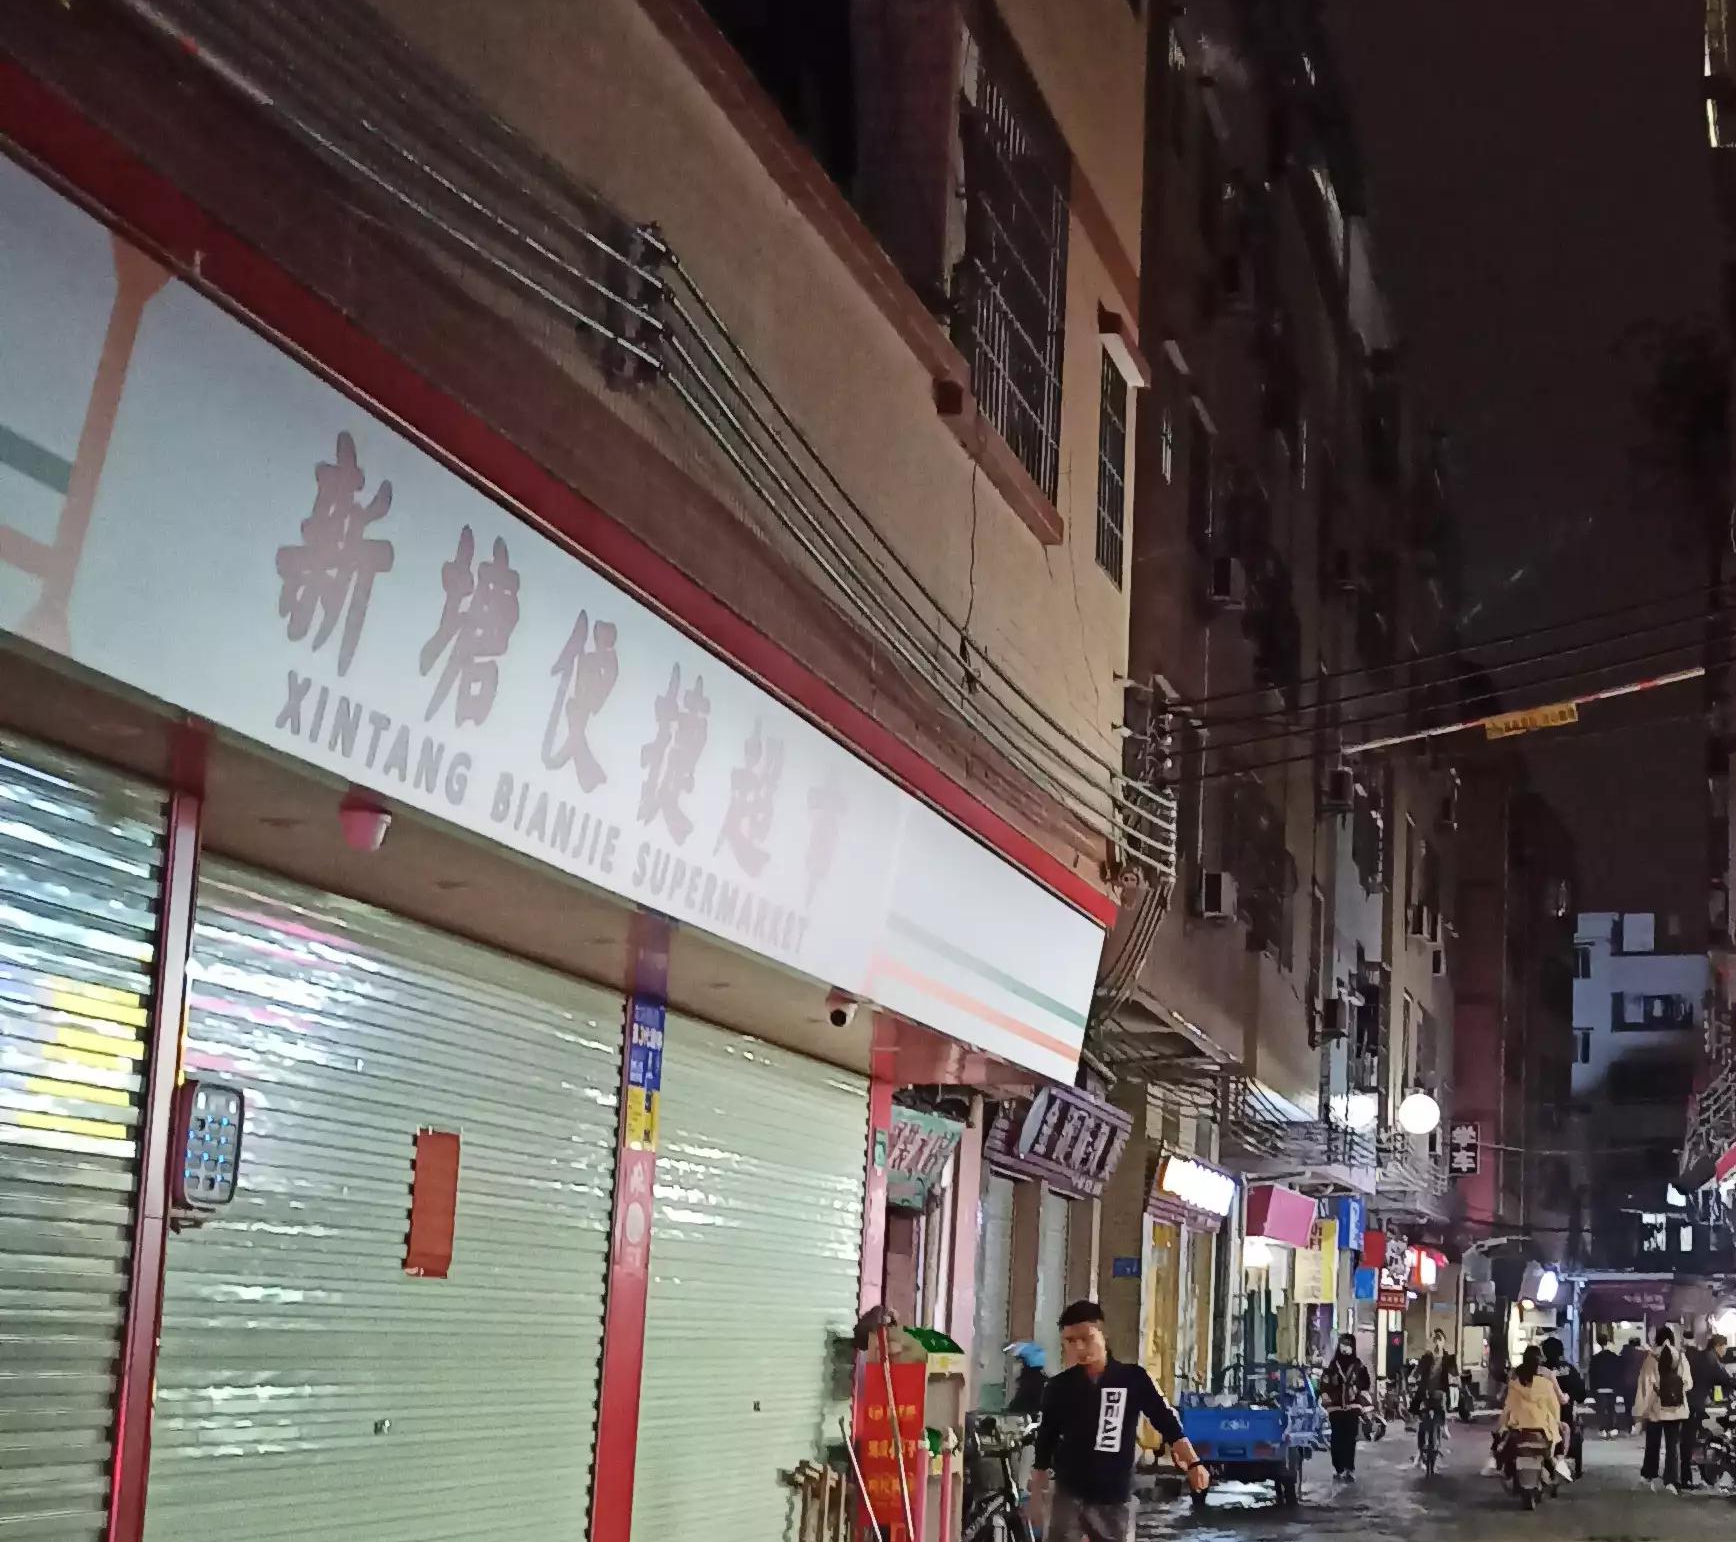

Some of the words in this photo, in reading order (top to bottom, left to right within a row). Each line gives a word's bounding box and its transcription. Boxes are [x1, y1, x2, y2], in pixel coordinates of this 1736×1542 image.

[274, 669, 473, 806] XINTANG
[490, 772, 622, 875] BIANJIE
[631, 840, 809, 955] SUPERMARKET
[275, 429, 850, 909] 新塘便捷超市
